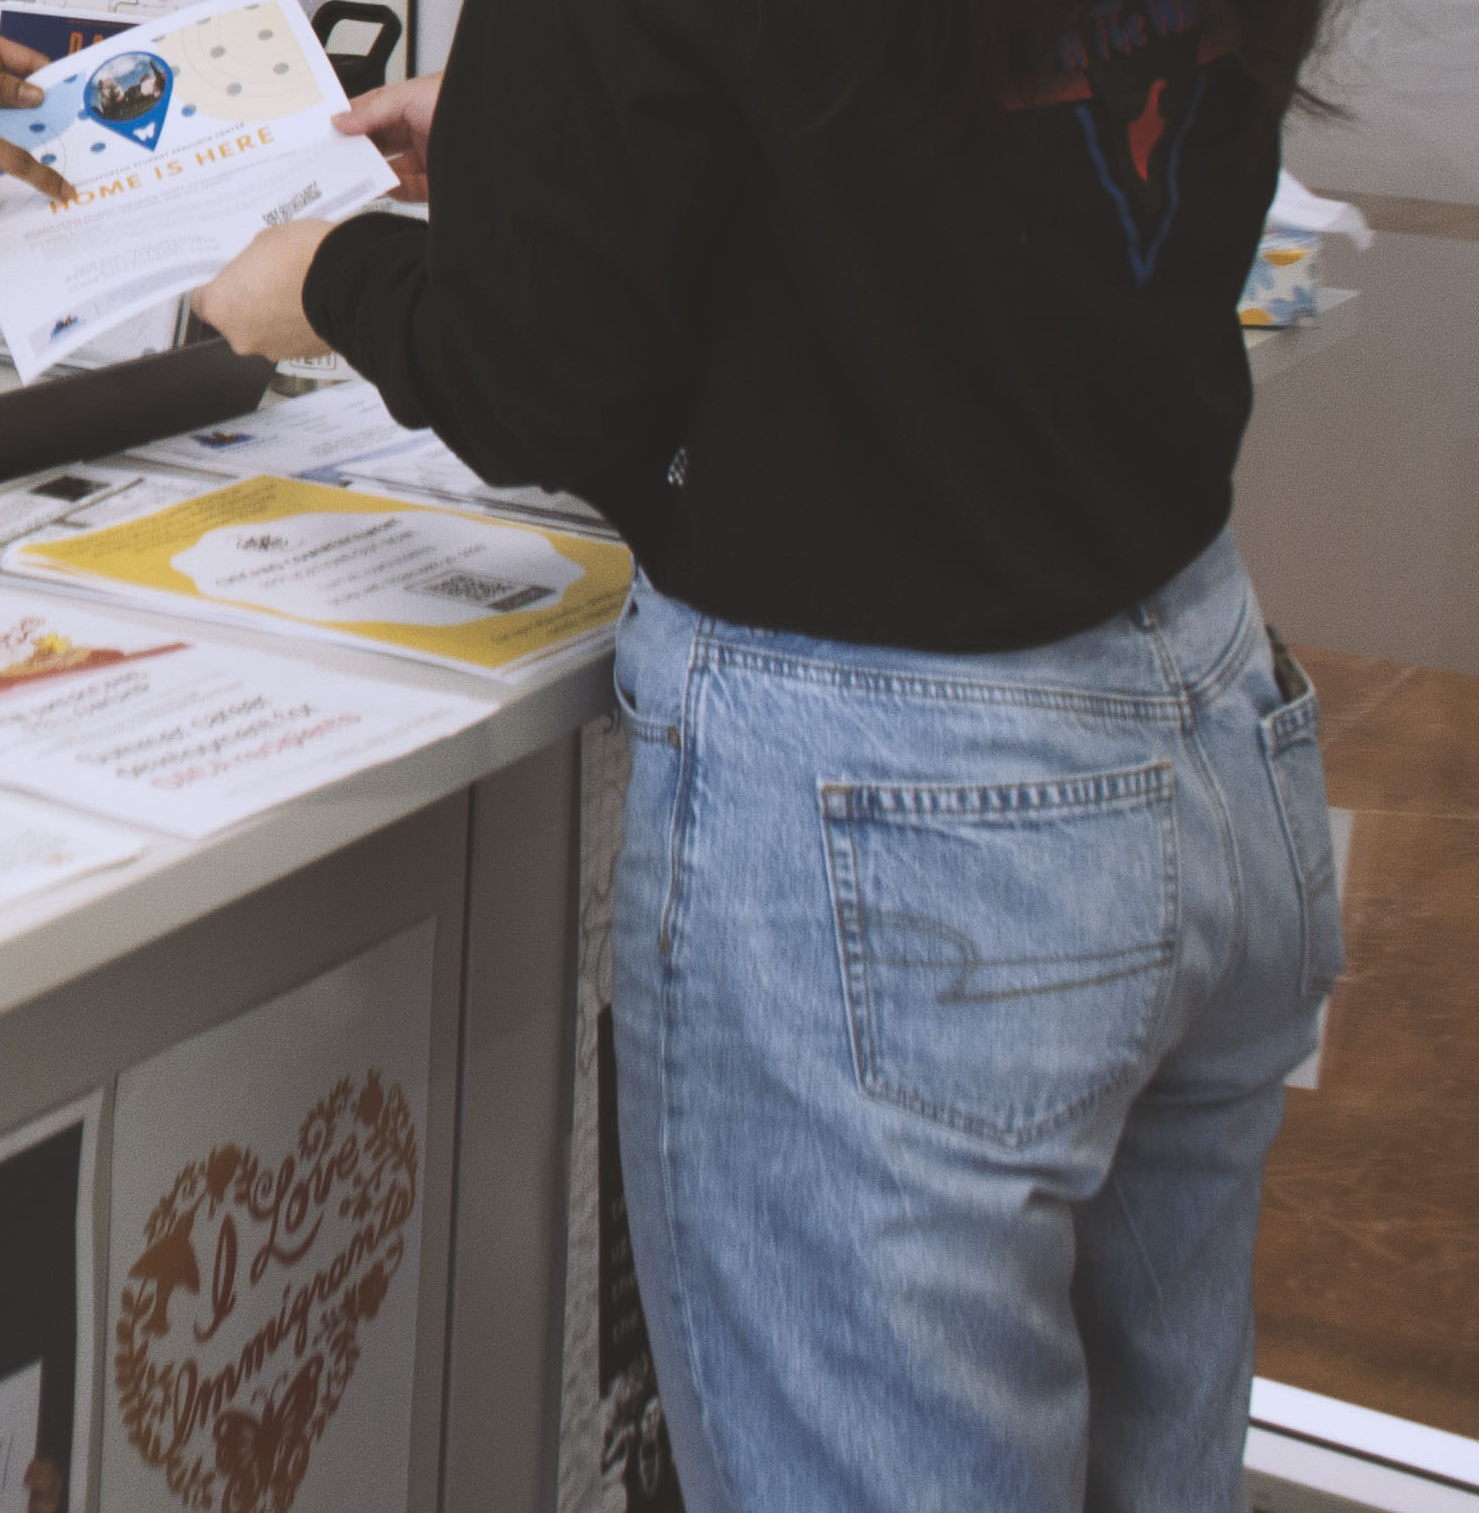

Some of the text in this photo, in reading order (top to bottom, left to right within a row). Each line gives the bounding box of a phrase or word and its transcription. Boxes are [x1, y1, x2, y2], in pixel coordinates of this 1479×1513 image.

[154, 160, 183, 181] IS
[194, 126, 275, 166] HERE
[248, 1133, 360, 1285] Love
